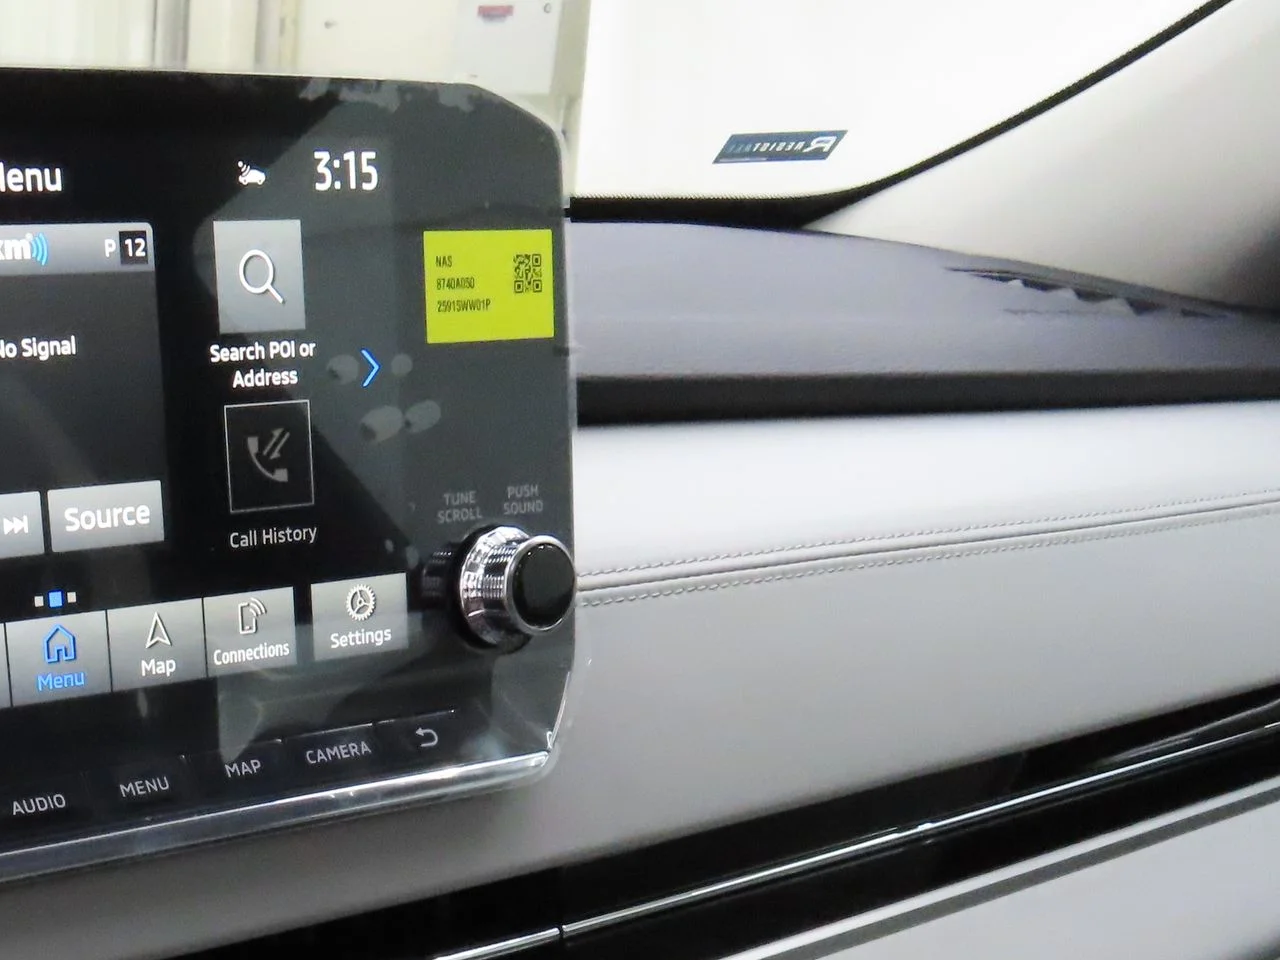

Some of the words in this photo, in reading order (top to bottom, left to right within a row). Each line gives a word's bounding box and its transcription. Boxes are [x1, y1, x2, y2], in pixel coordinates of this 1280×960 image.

[314, 150, 379, 191] 3:15
[105, 241, 116, 258] P
[124, 238, 147, 258] 12
[435, 255, 453, 268] NAS
[21, 335, 77, 360] Signal
[210, 341, 265, 363] Search
[270, 341, 296, 360] POI
[299, 342, 316, 359] or
[232, 367, 298, 389] Address
[443, 490, 477, 506] TUNE
[507, 484, 538, 499] PUSH
[64, 503, 150, 532] Source
[437, 506, 483, 524] SCROLL
[503, 500, 544, 515] SOUND
[229, 528, 258, 549] Call
[262, 524, 318, 550] History
[330, 626, 392, 651] Settings
[213, 640, 290, 667] Connections
[141, 657, 176, 679] Map
[36, 670, 85, 693] Menu
[305, 741, 372, 765] CAMERA
[224, 758, 262, 779] MAP
[119, 775, 170, 799] MENU
[11, 792, 67, 817] AUDIO
